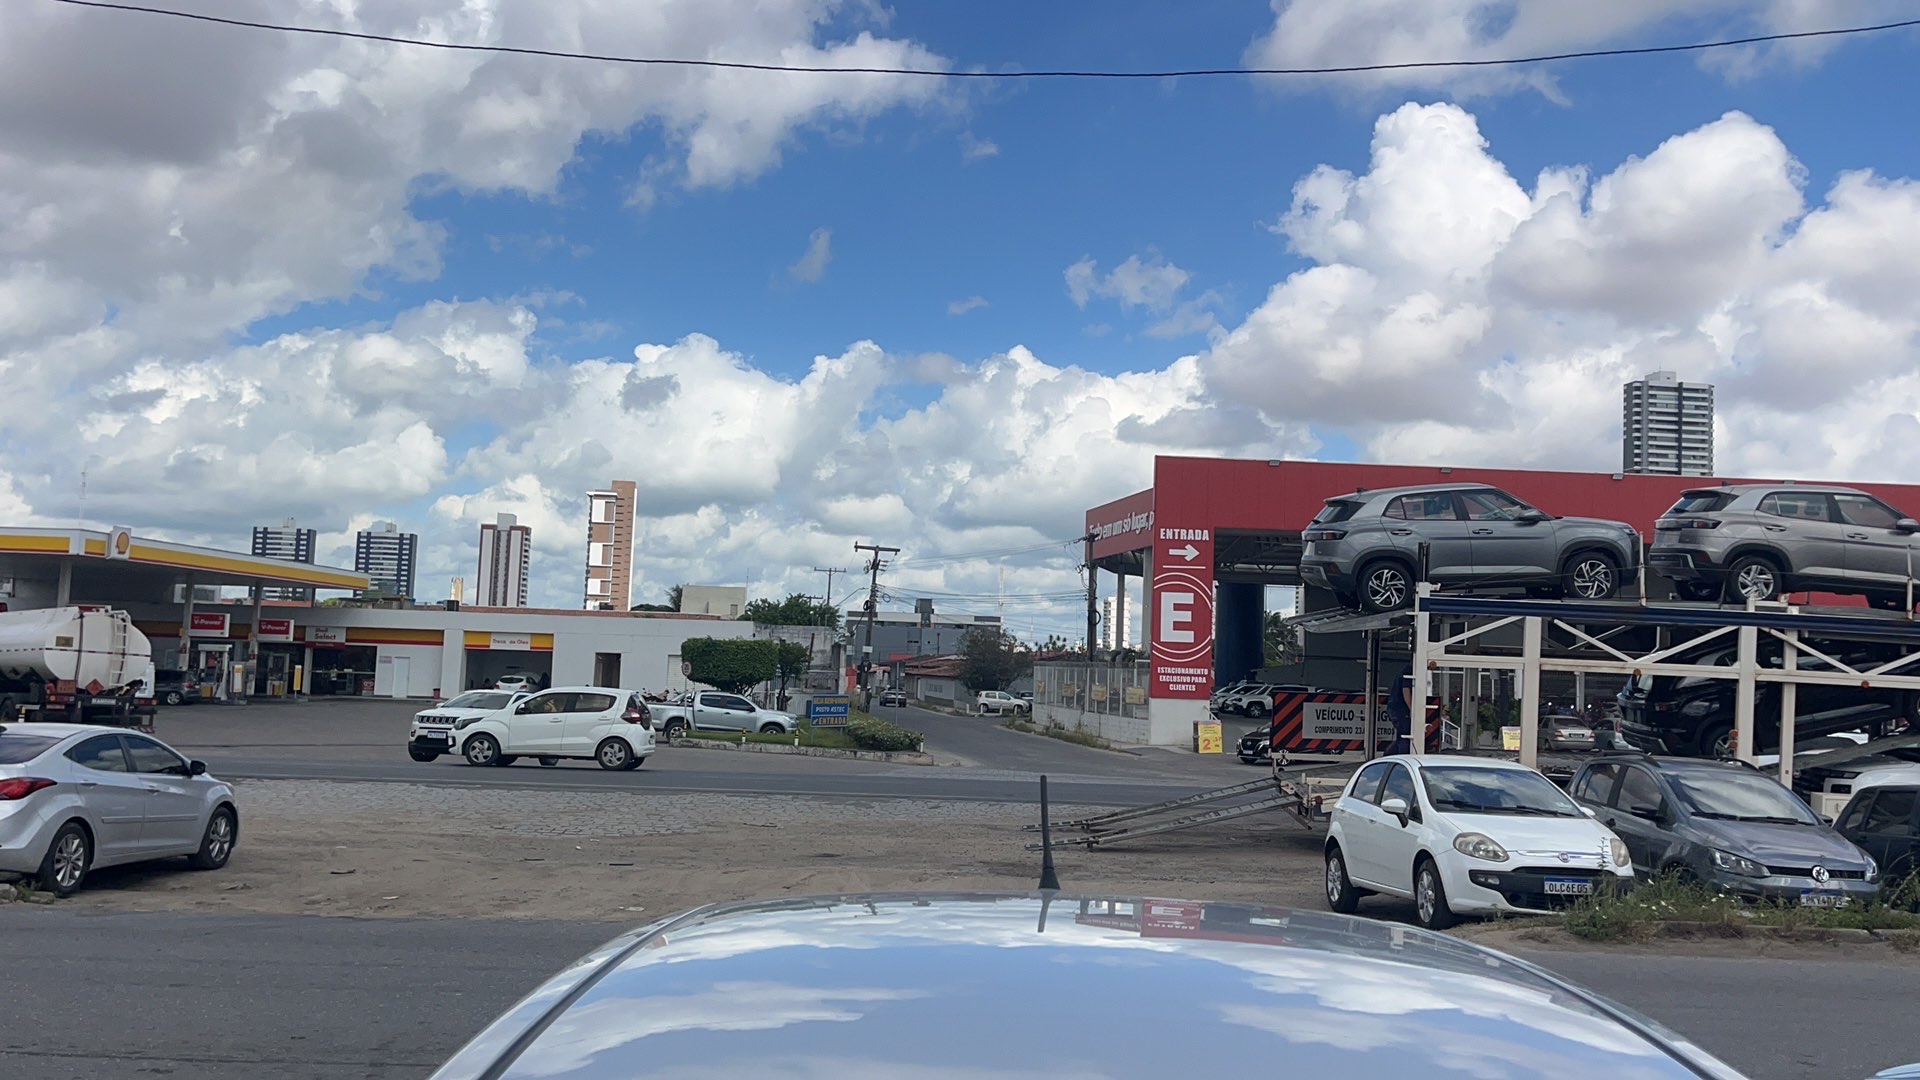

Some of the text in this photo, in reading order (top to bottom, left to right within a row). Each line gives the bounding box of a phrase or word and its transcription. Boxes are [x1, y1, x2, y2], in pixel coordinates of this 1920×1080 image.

[1103, 523, 1112, 539] em
[1160, 528, 1209, 541] ENTRADA
[1161, 591, 1194, 643] E
[315, 632, 336, 640] Select
[1157, 666, 1209, 675] ESTACIONAMENTO
[1159, 675, 1190, 683] EXCLUSIVO
[1315, 706, 1355, 721] VEÍCULO
[818, 716, 847, 725] ENTRADA
[1314, 726, 1353, 735] COMPRIMENTO
[1376, 727, 1396, 735] ETROS
